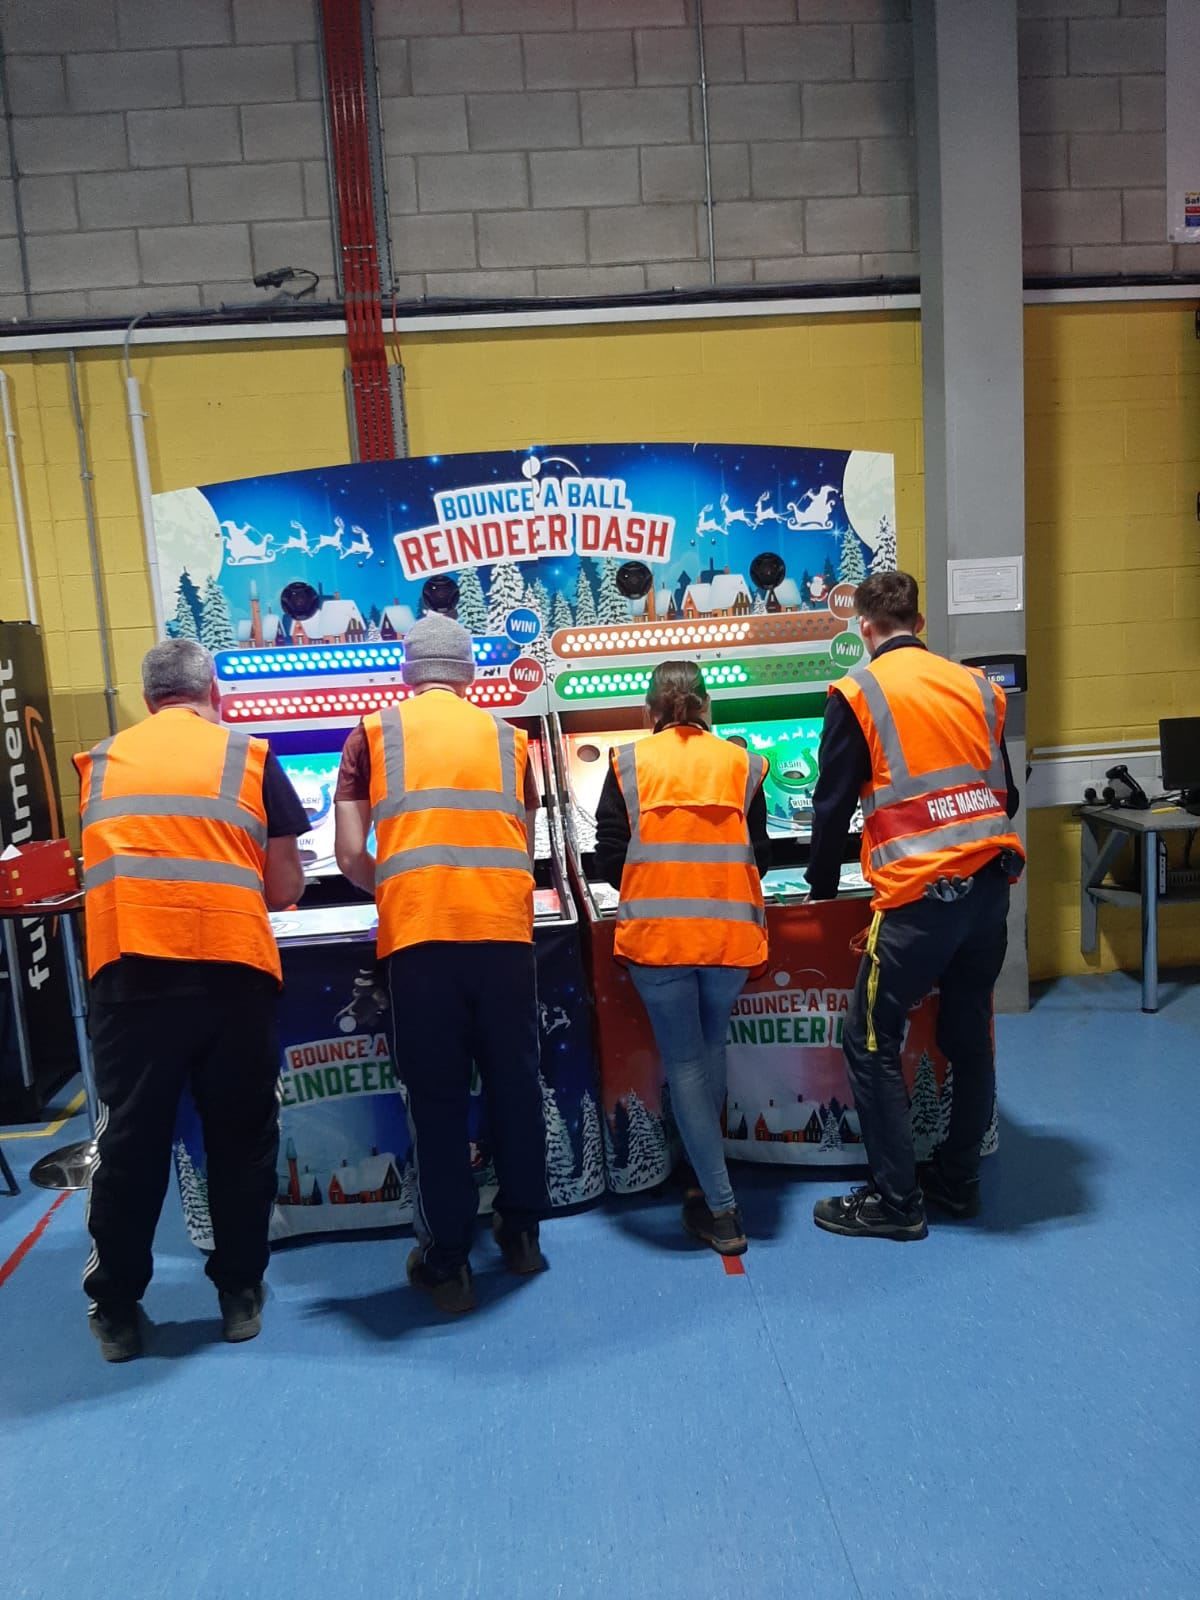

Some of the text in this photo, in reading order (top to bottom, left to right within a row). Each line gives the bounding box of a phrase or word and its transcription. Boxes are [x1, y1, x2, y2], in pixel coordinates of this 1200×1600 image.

[440, 482, 626, 523] BOUNCE A BALL
[400, 514, 669, 575] REINDEER DASH
[834, 593, 855, 608] WIN
[510, 618, 537, 634] WIN!
[927, 787, 1000, 821] FIRE MARSHA
[808, 992, 819, 1012] A
[826, 992, 849, 1012] BA
[724, 1016, 826, 1045] INDEER
[290, 1037, 388, 1069] BOUNCE A
[282, 1061, 396, 1107] EINDEER
